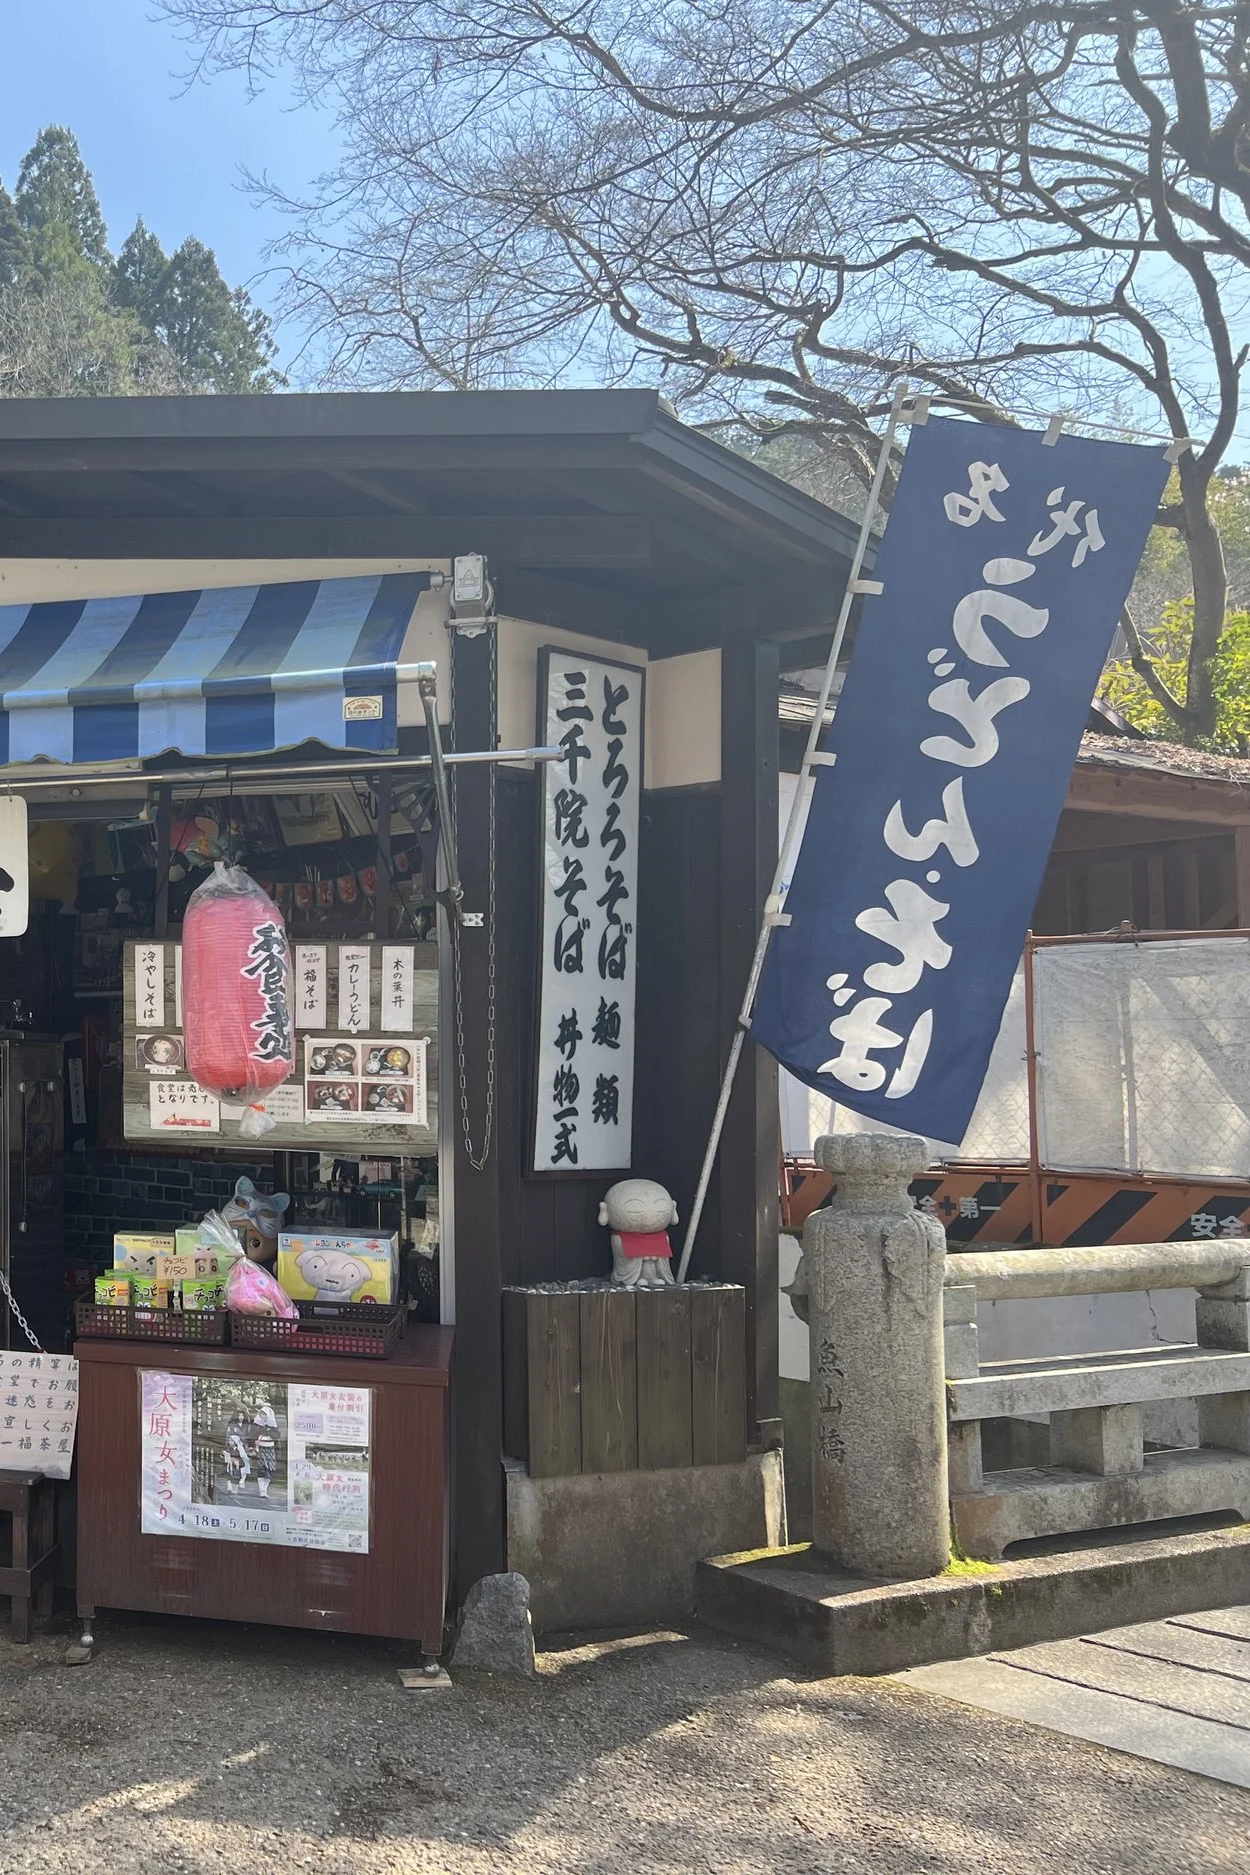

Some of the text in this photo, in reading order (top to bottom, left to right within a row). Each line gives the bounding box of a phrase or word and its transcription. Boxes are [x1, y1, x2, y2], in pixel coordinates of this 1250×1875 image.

[550, 671, 594, 1165] 三千院そば 丼物一式
[592, 674, 633, 1126] とろろそば 麺類
[142, 951, 157, 1019] 冷やしそば
[303, 969, 318, 1010] 福そば
[347, 964, 361, 1026] カレーうどん
[959, 1196, 1002, 1220] 第一
[1190, 1212, 1246, 1239] 安全
[163, 1265, 188, 1275] ¥150
[149, 1385, 178, 1521] 大原女まつり
